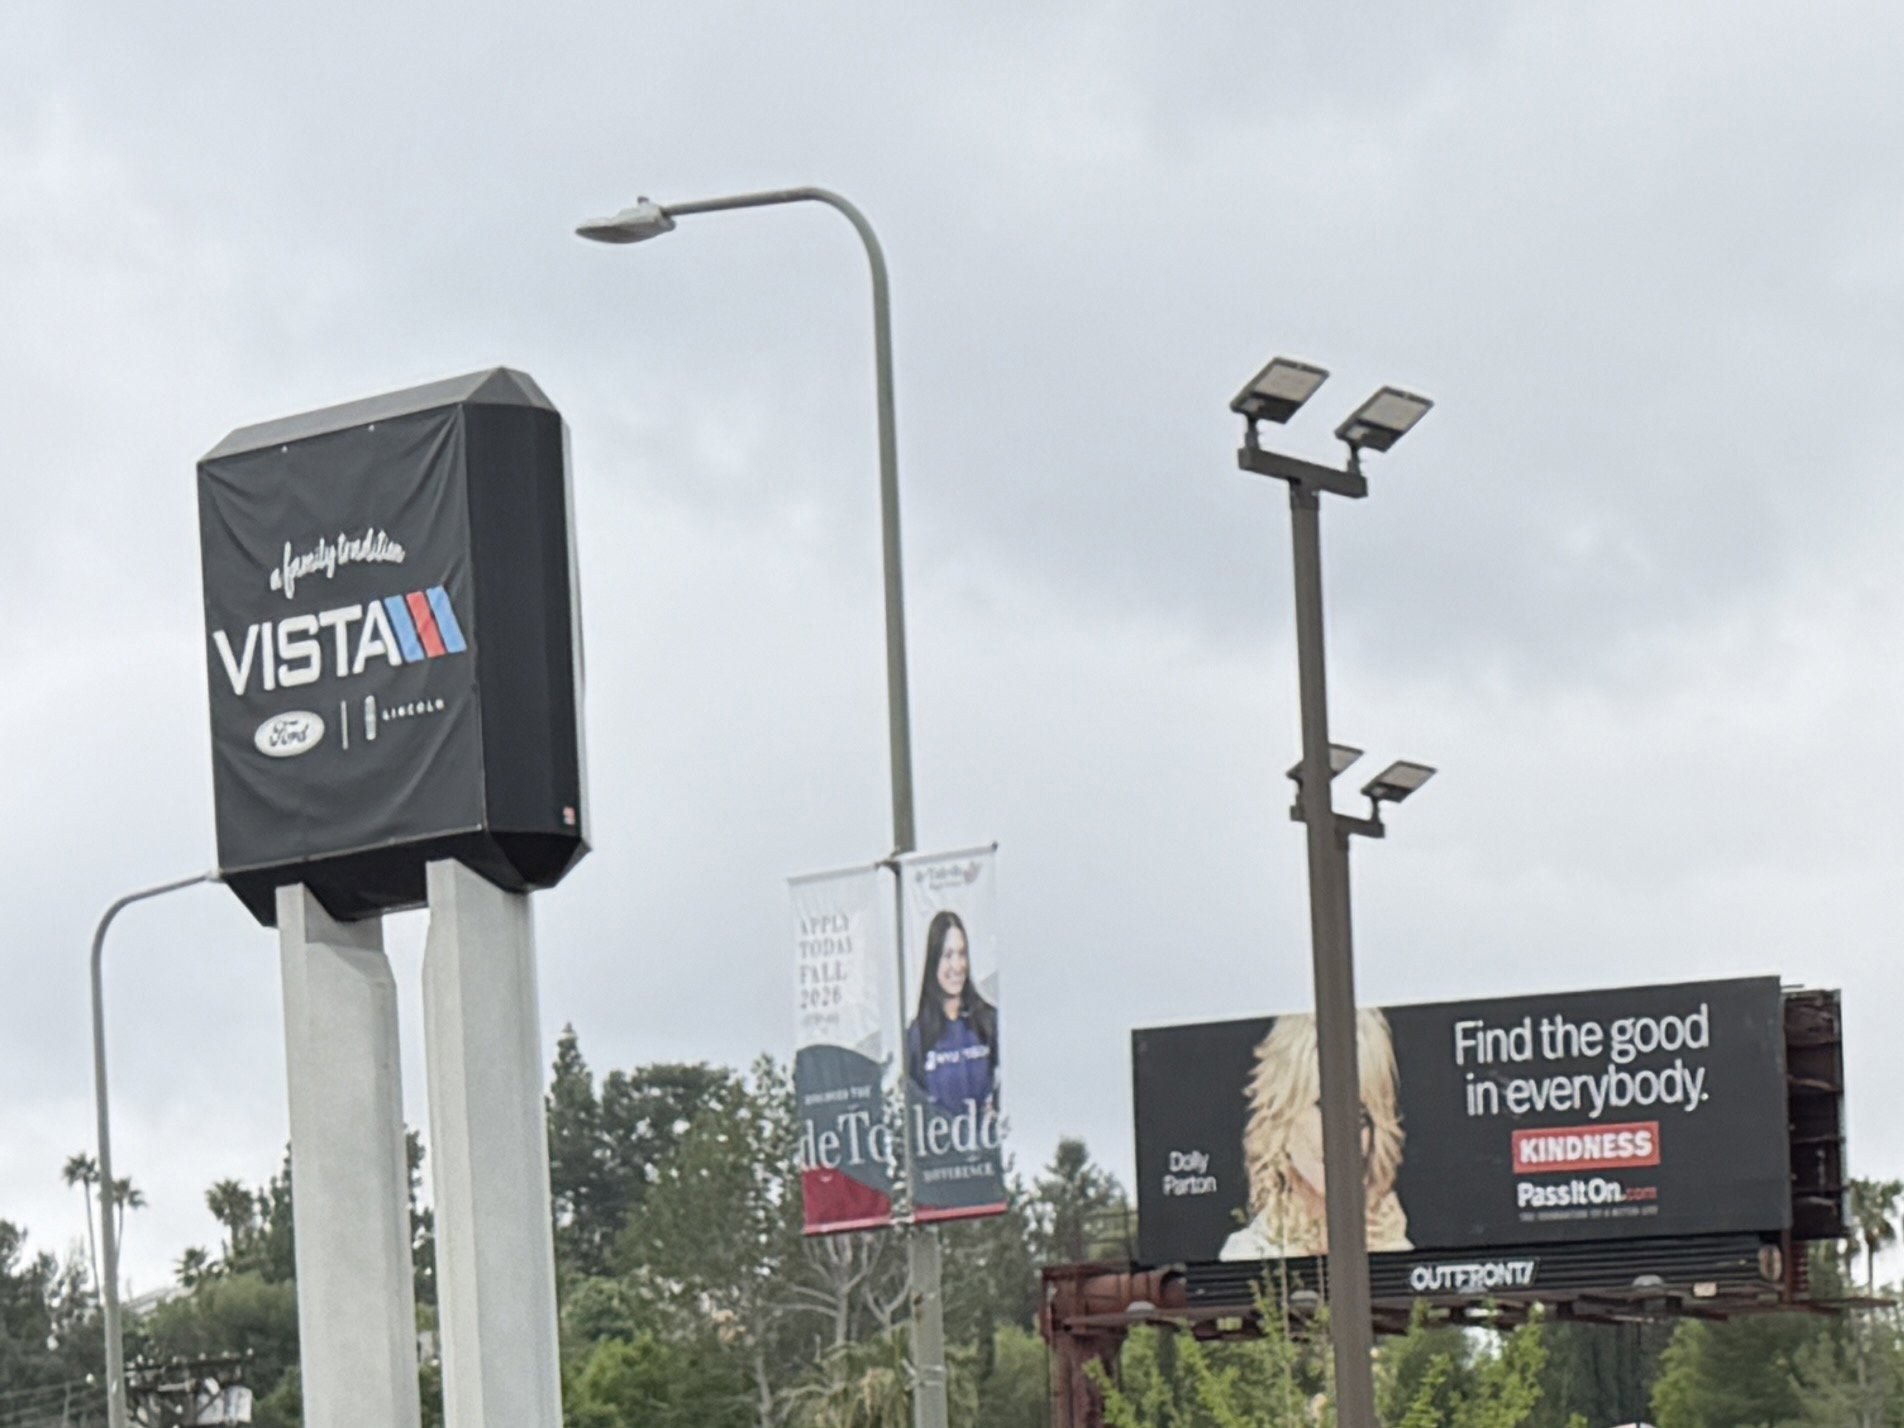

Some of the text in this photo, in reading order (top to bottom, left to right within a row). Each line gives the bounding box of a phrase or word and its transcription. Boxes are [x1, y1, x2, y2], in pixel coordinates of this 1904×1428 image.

[213, 600, 402, 695] VISTA
[801, 960, 848, 984] FALL
[1455, 1003, 1709, 1065] Find the good
[1466, 1058, 1709, 1118] in everybody.
[1520, 1131, 1653, 1163] KINDNESS
